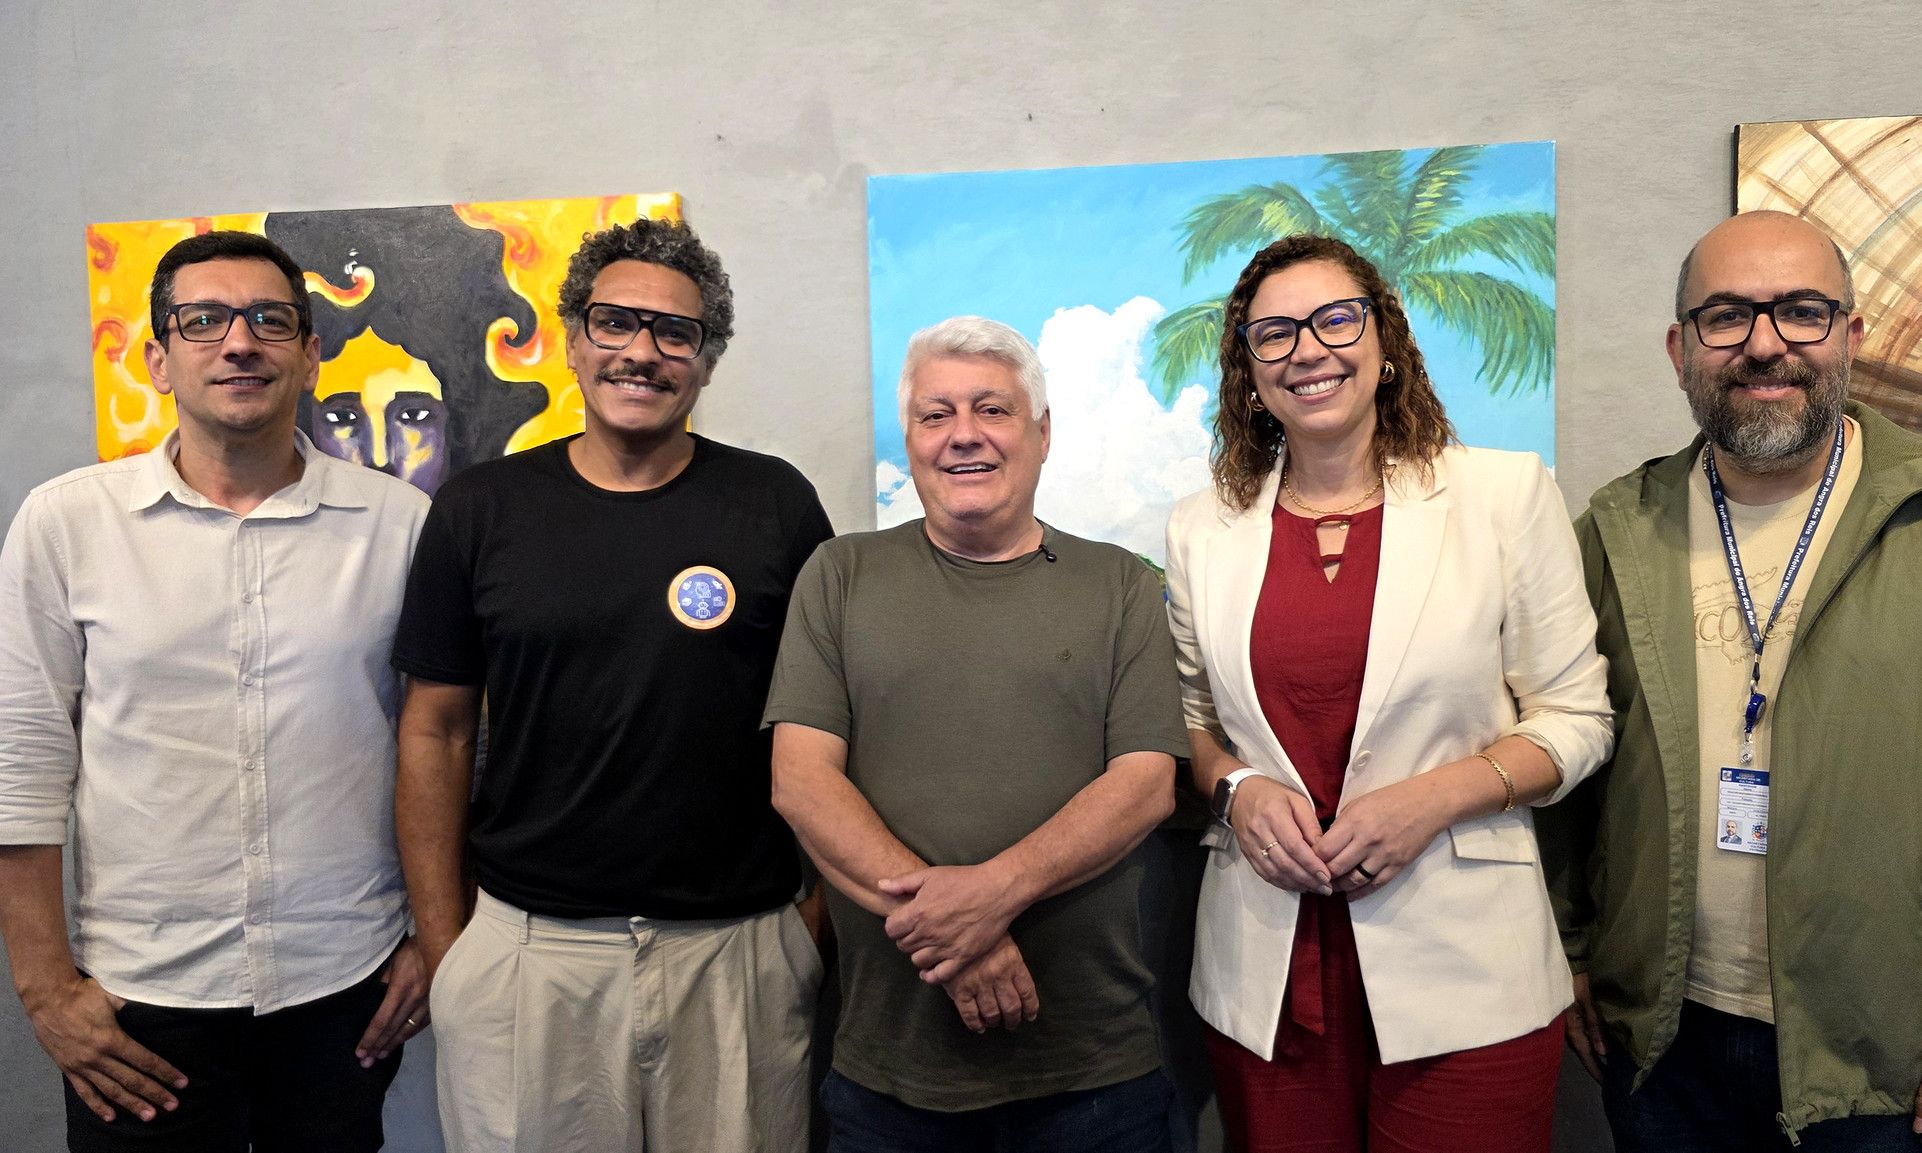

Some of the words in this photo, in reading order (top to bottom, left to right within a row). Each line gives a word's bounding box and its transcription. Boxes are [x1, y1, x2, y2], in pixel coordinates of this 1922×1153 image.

[1829, 447, 1842, 477] Municipal
[1816, 487, 1829, 506] Angra
[1811, 507, 1821, 519] dos
[1805, 520, 1816, 535] Reis
[1718, 504, 1730, 535] Prefeitura
[1726, 536, 1740, 567] Municipal
[1737, 577, 1747, 596] Angra
[1742, 597, 1750, 609] dos
[1747, 610, 1755, 625] Reis
[1785, 548, 1804, 581] Prefeitura
